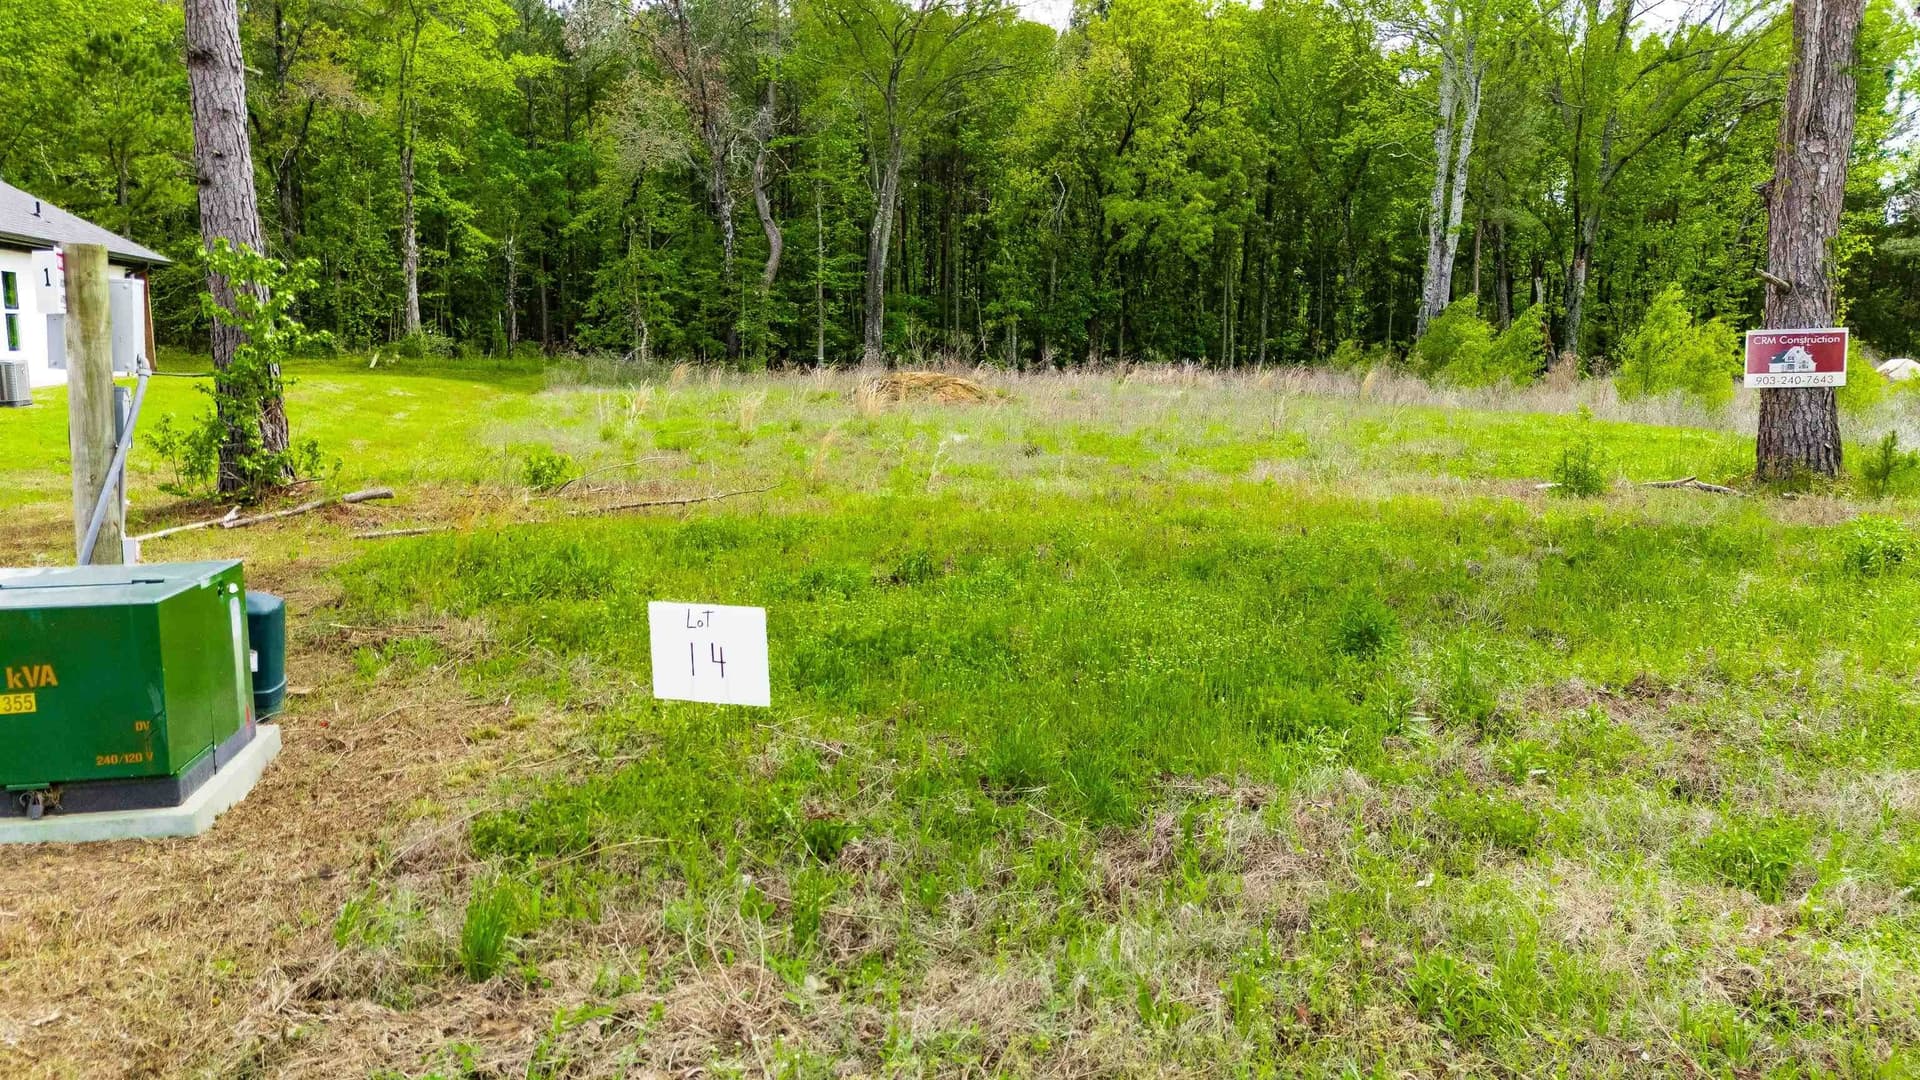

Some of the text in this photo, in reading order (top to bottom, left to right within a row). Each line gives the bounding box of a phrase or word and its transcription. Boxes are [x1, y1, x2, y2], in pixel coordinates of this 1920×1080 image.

[1753, 335, 1841, 345] CRM Construction
[1755, 375, 1834, 386] 903-240-7643
[690, 642, 727, 678] 14
[6, 664, 59, 689] kVA
[2, 695, 34, 712] 355
[96, 751, 153, 767] 240/120 V
